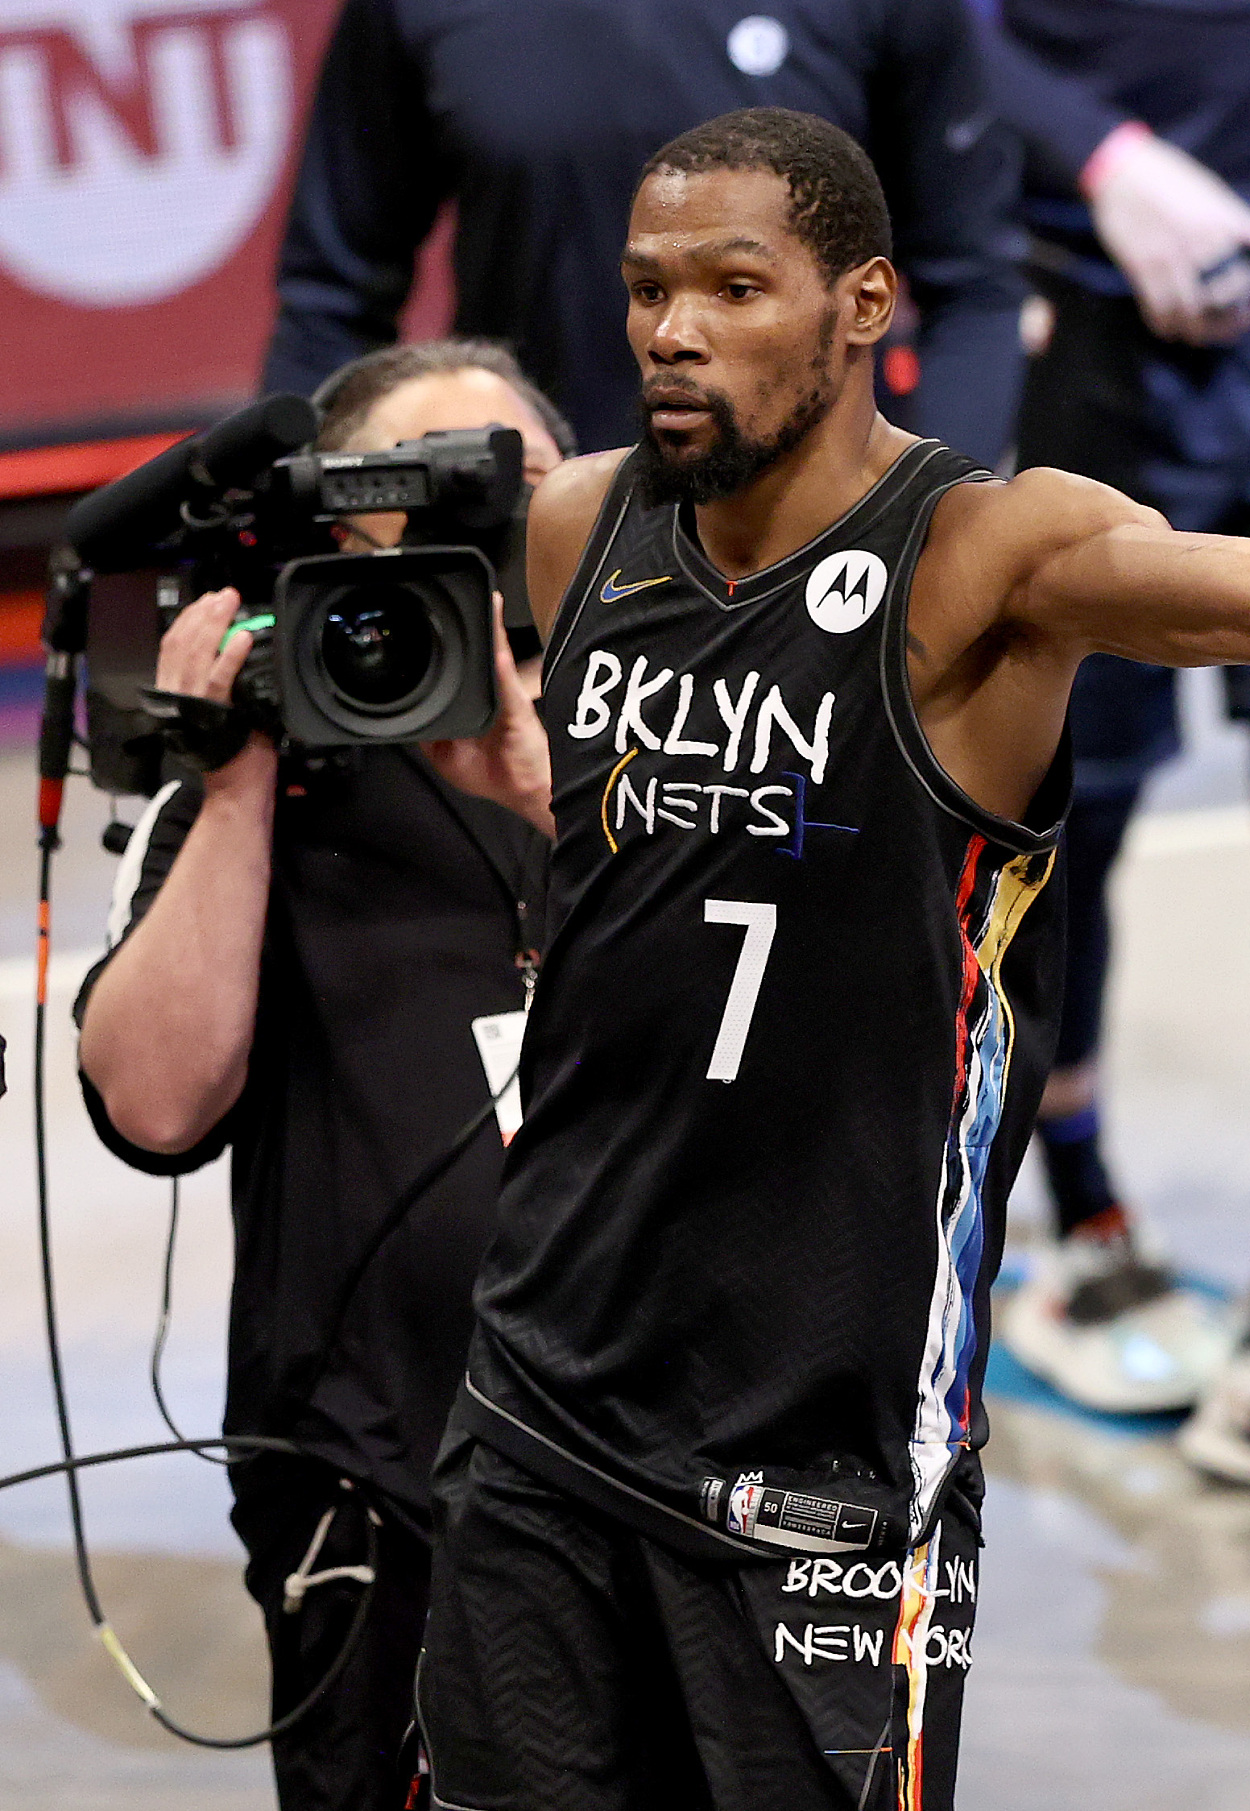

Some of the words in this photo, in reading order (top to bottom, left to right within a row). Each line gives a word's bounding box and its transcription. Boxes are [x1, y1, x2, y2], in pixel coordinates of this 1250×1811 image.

[567, 650, 836, 783] BKLYN
[703, 899, 777, 1082] 7
[763, 1501, 778, 1514] 50
[782, 1555, 975, 1603] BROOKLYN
[774, 1622, 884, 1667] NEW
